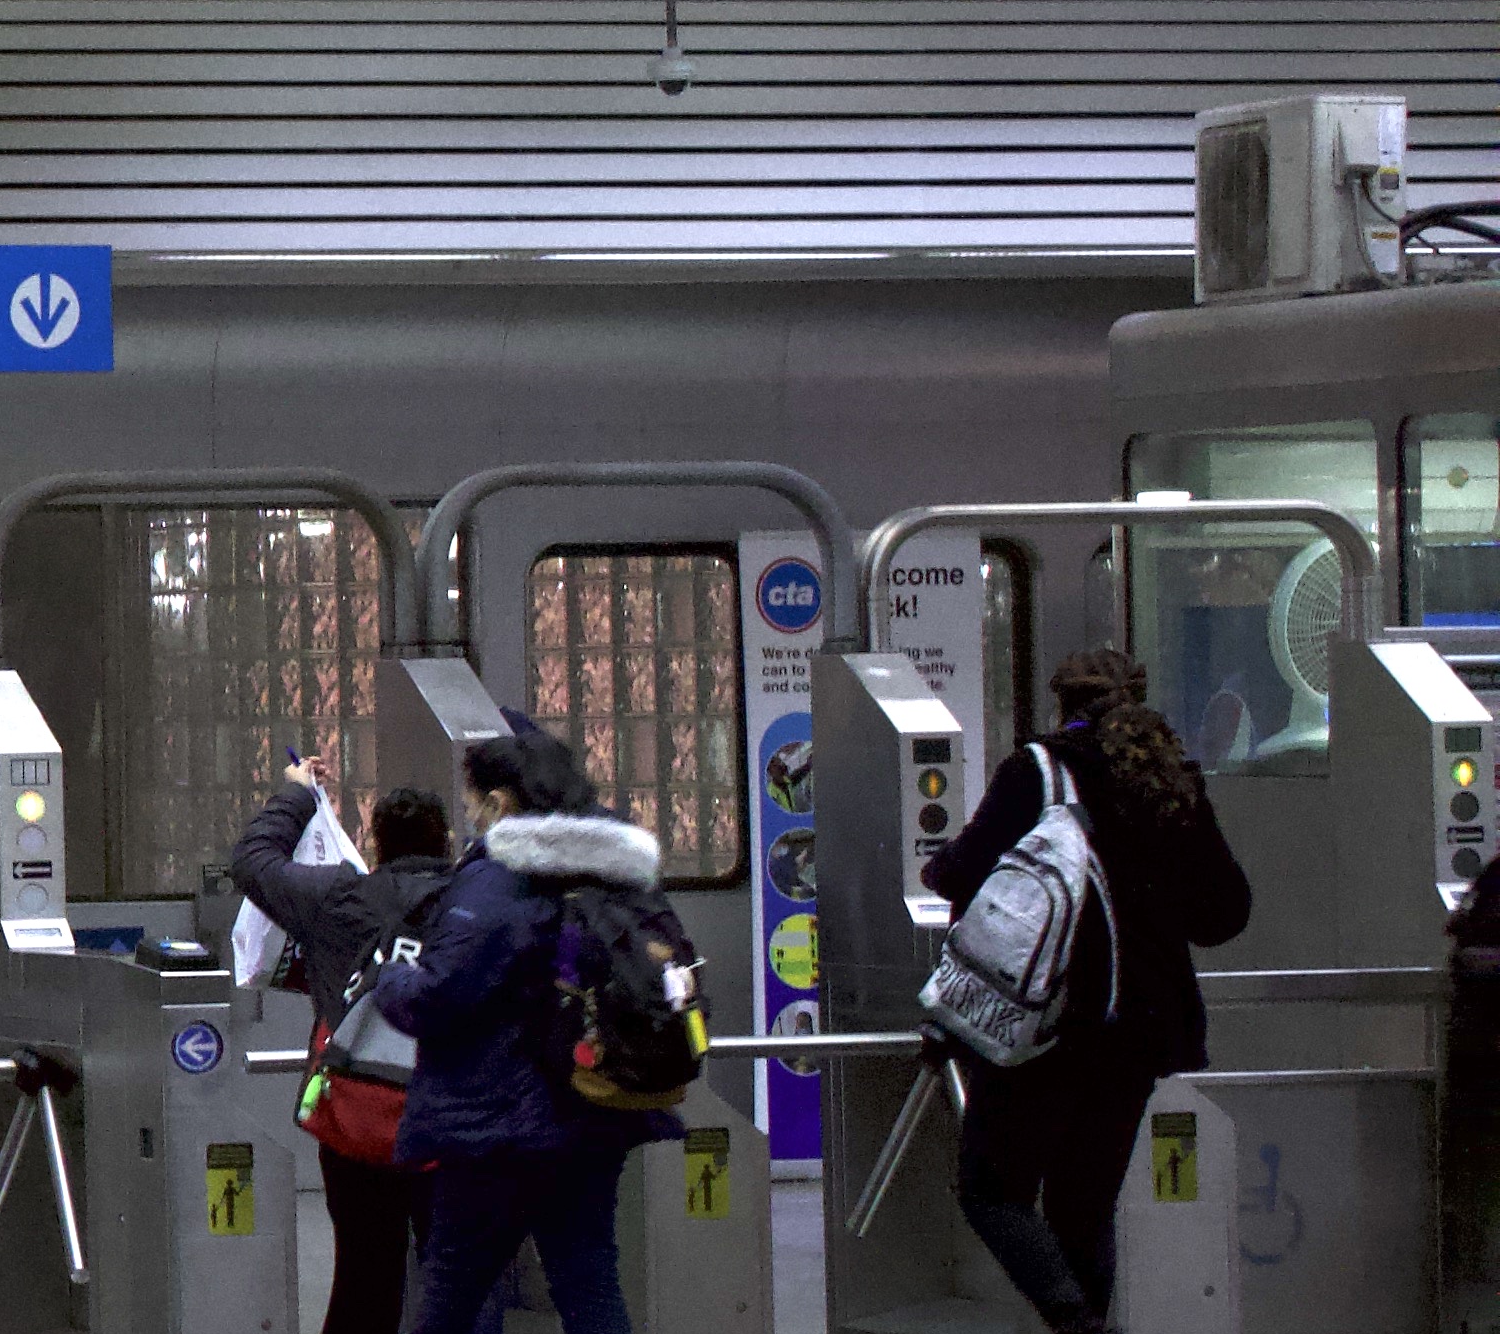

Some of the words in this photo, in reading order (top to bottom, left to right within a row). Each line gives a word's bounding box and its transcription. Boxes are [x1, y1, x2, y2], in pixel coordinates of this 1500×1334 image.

[888, 567, 965, 586] come
[768, 581, 814, 607] cta
[761, 647, 801, 660] We're
[924, 648, 944, 658] we
[761, 666, 788, 676] can
[792, 664, 806, 677] to
[914, 662, 956, 677] ealthy
[762, 679, 789, 693] and
